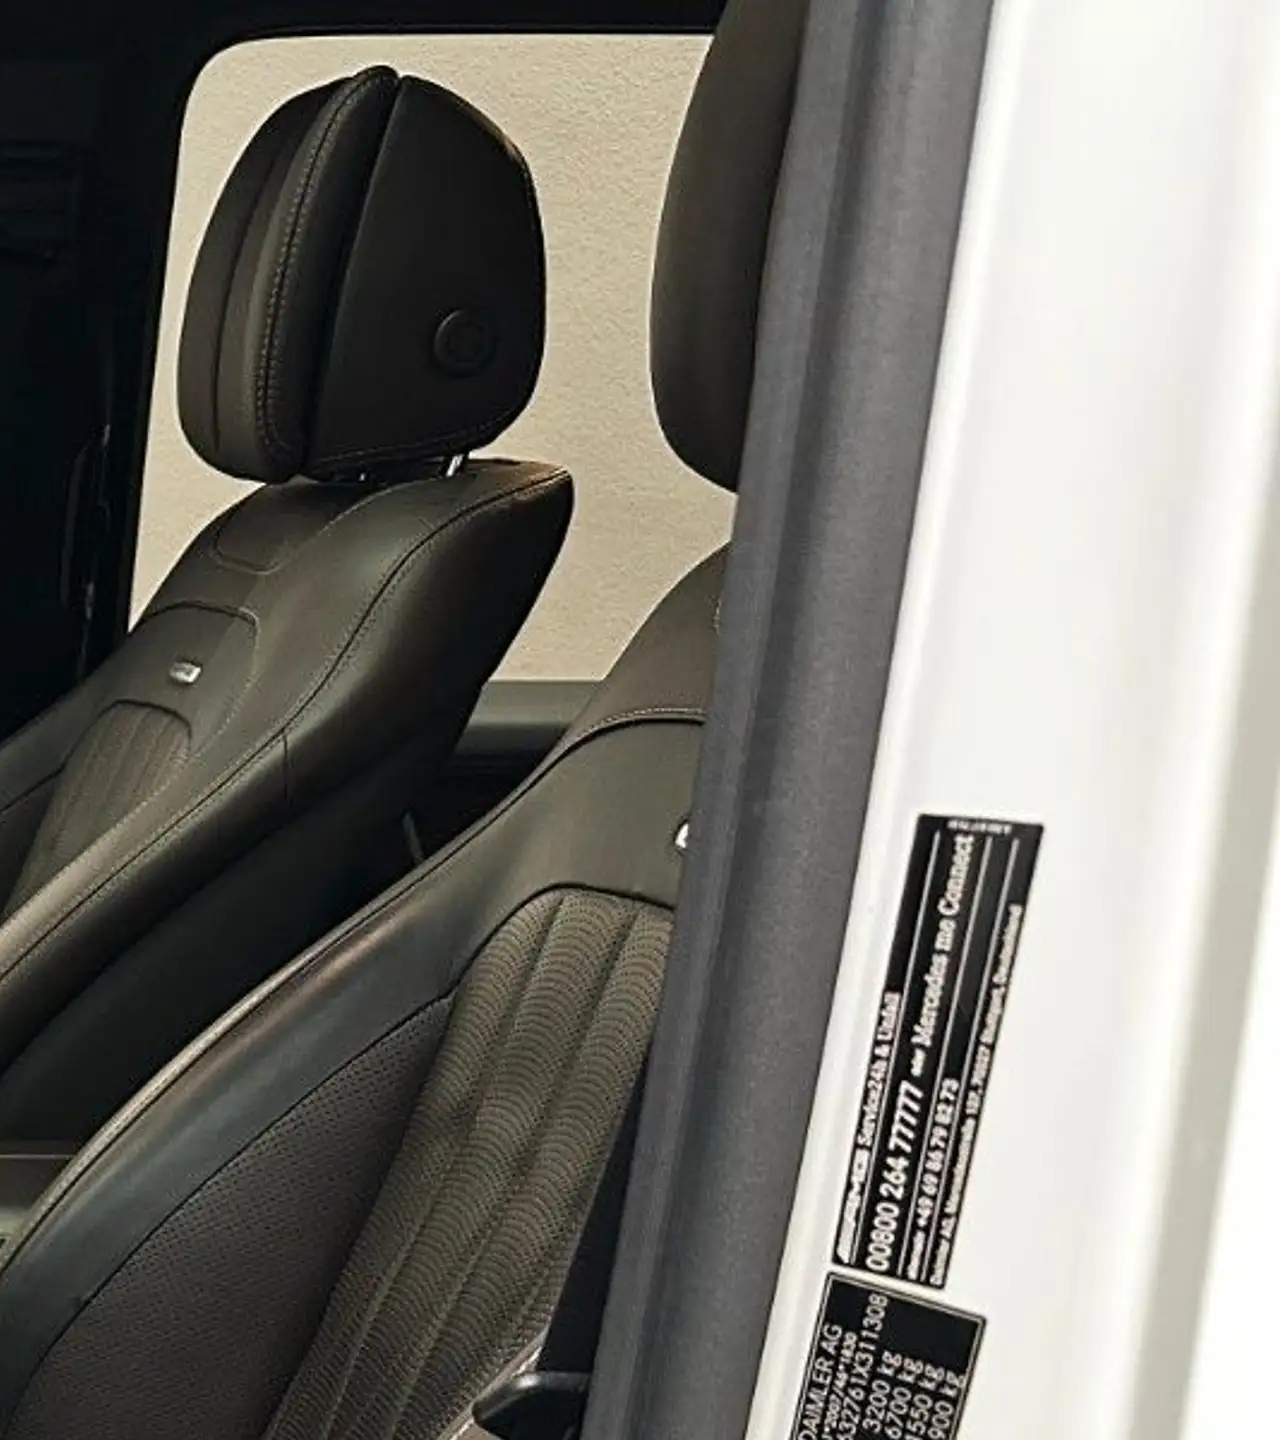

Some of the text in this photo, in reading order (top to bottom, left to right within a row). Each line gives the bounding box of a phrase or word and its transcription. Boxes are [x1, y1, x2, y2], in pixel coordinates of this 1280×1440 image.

[938, 834, 973, 915] Connect
[935, 918, 955, 950] me
[912, 954, 947, 1045] Mercedes
[889, 1081, 922, 1151] 77777
[879, 1157, 908, 1198] 264
[866, 1202, 898, 1270] 00800
[821, 1325, 841, 1354] AG
[862, 1351, 901, 1432] 3200 kg
[885, 1358, 922, 1438] 6700 kg
[918, 1364, 944, 1390] kg
[940, 1371, 965, 1396] kg
